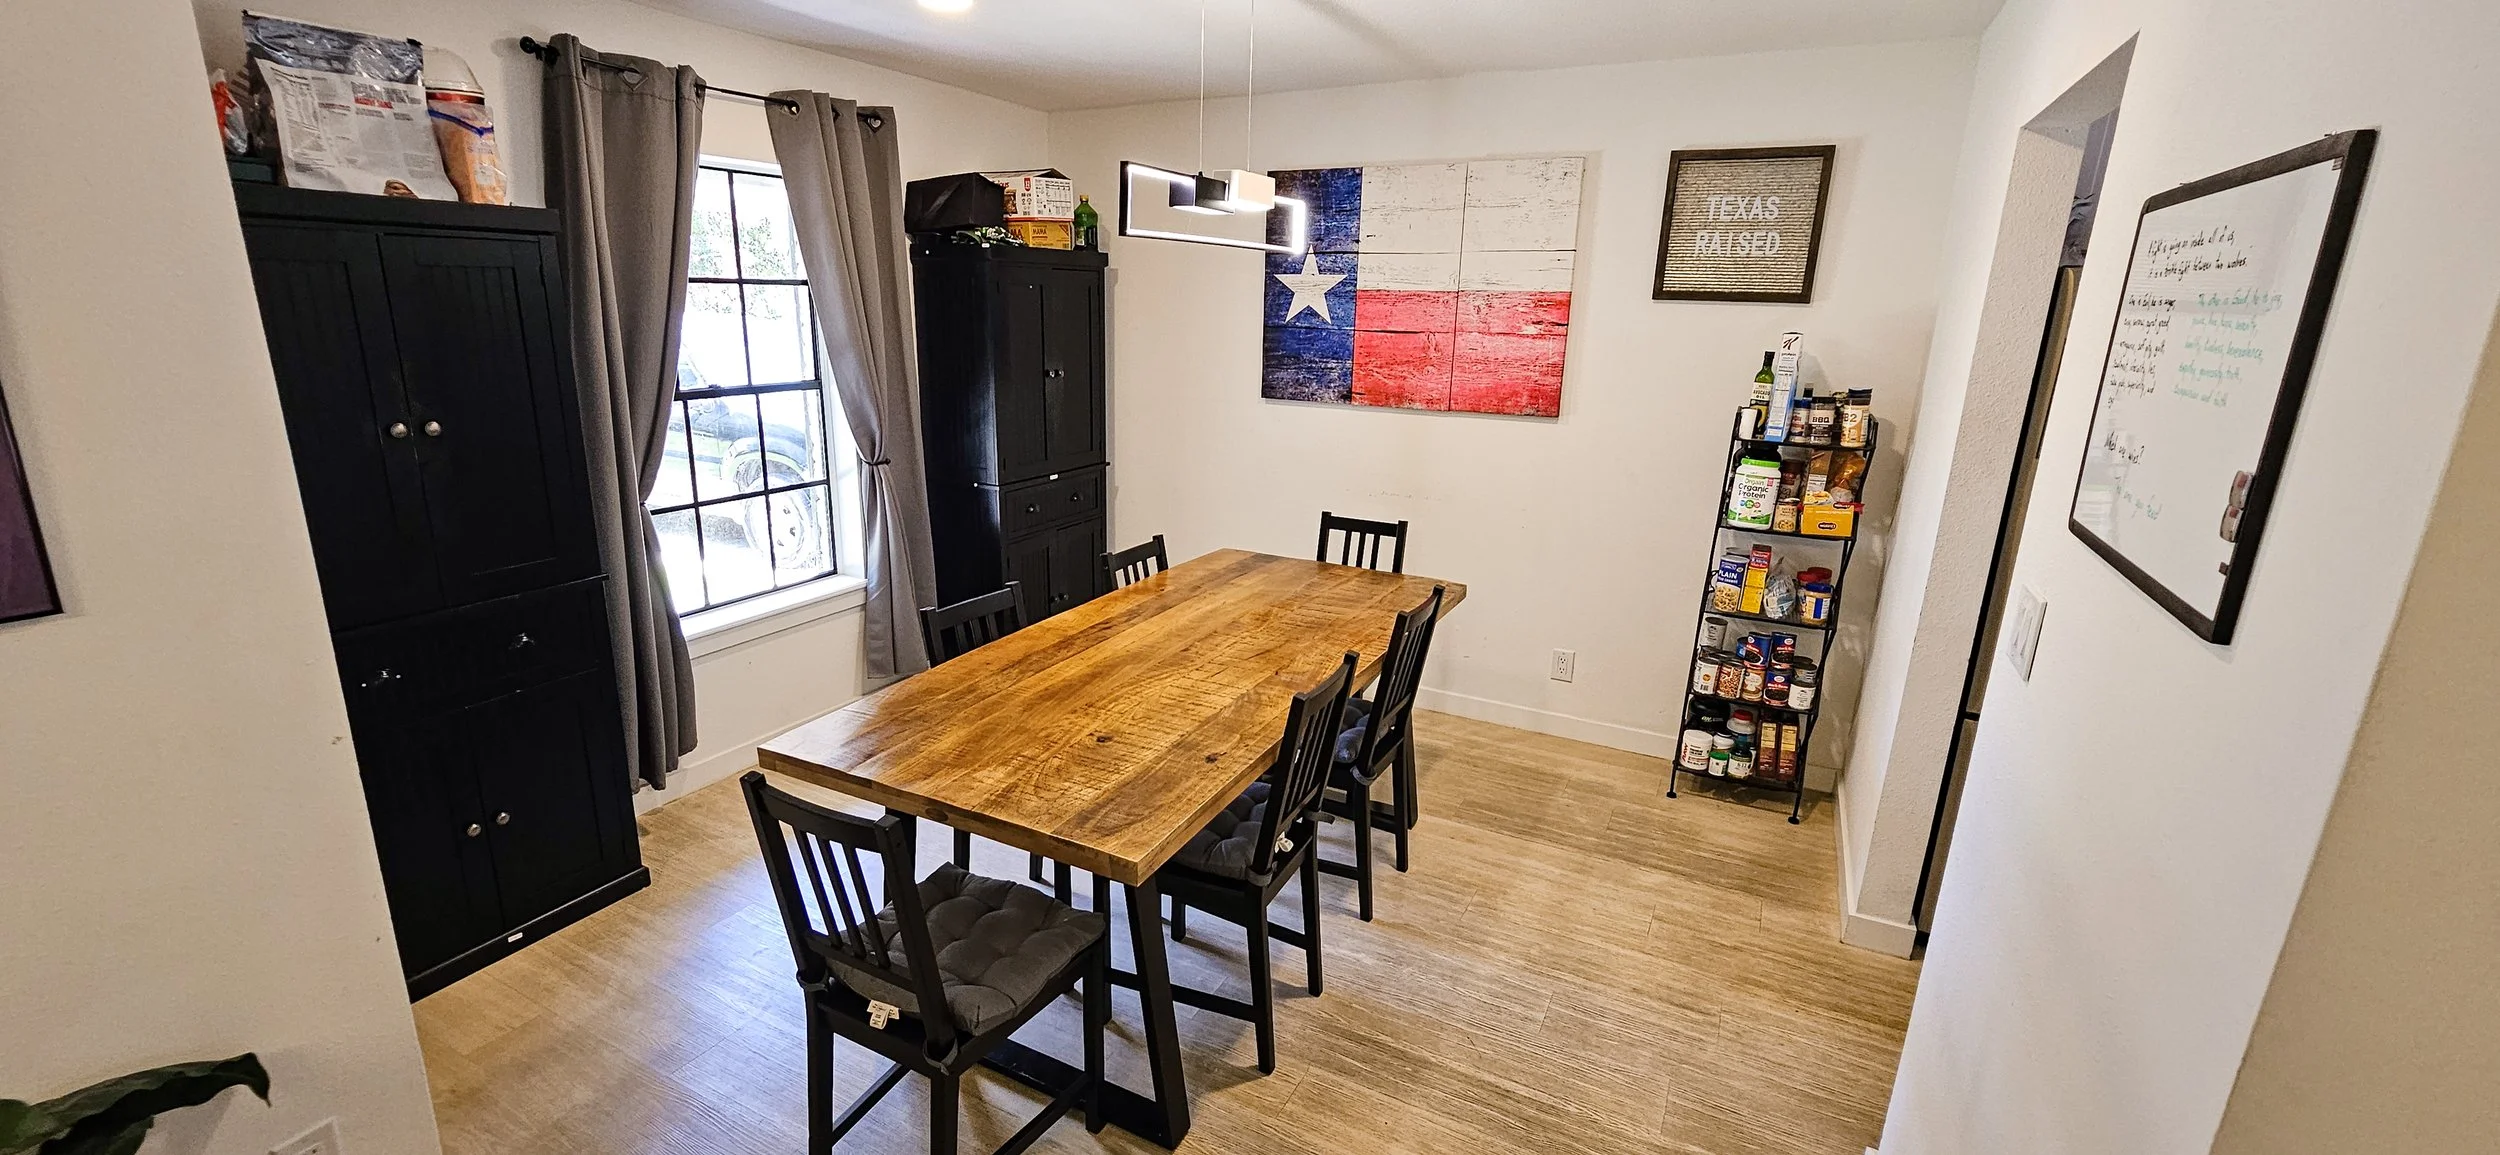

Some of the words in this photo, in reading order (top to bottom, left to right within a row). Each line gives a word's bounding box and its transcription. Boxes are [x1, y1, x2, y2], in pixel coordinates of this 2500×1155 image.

[1706, 195, 1781, 222] TEXAS
[1694, 230, 1781, 256] RAISED
[1783, 336, 1799, 350] K
[1812, 416, 1830, 424] BBQ
[1738, 483, 1769, 493] Organic
[1738, 490, 1766, 499] Protein
